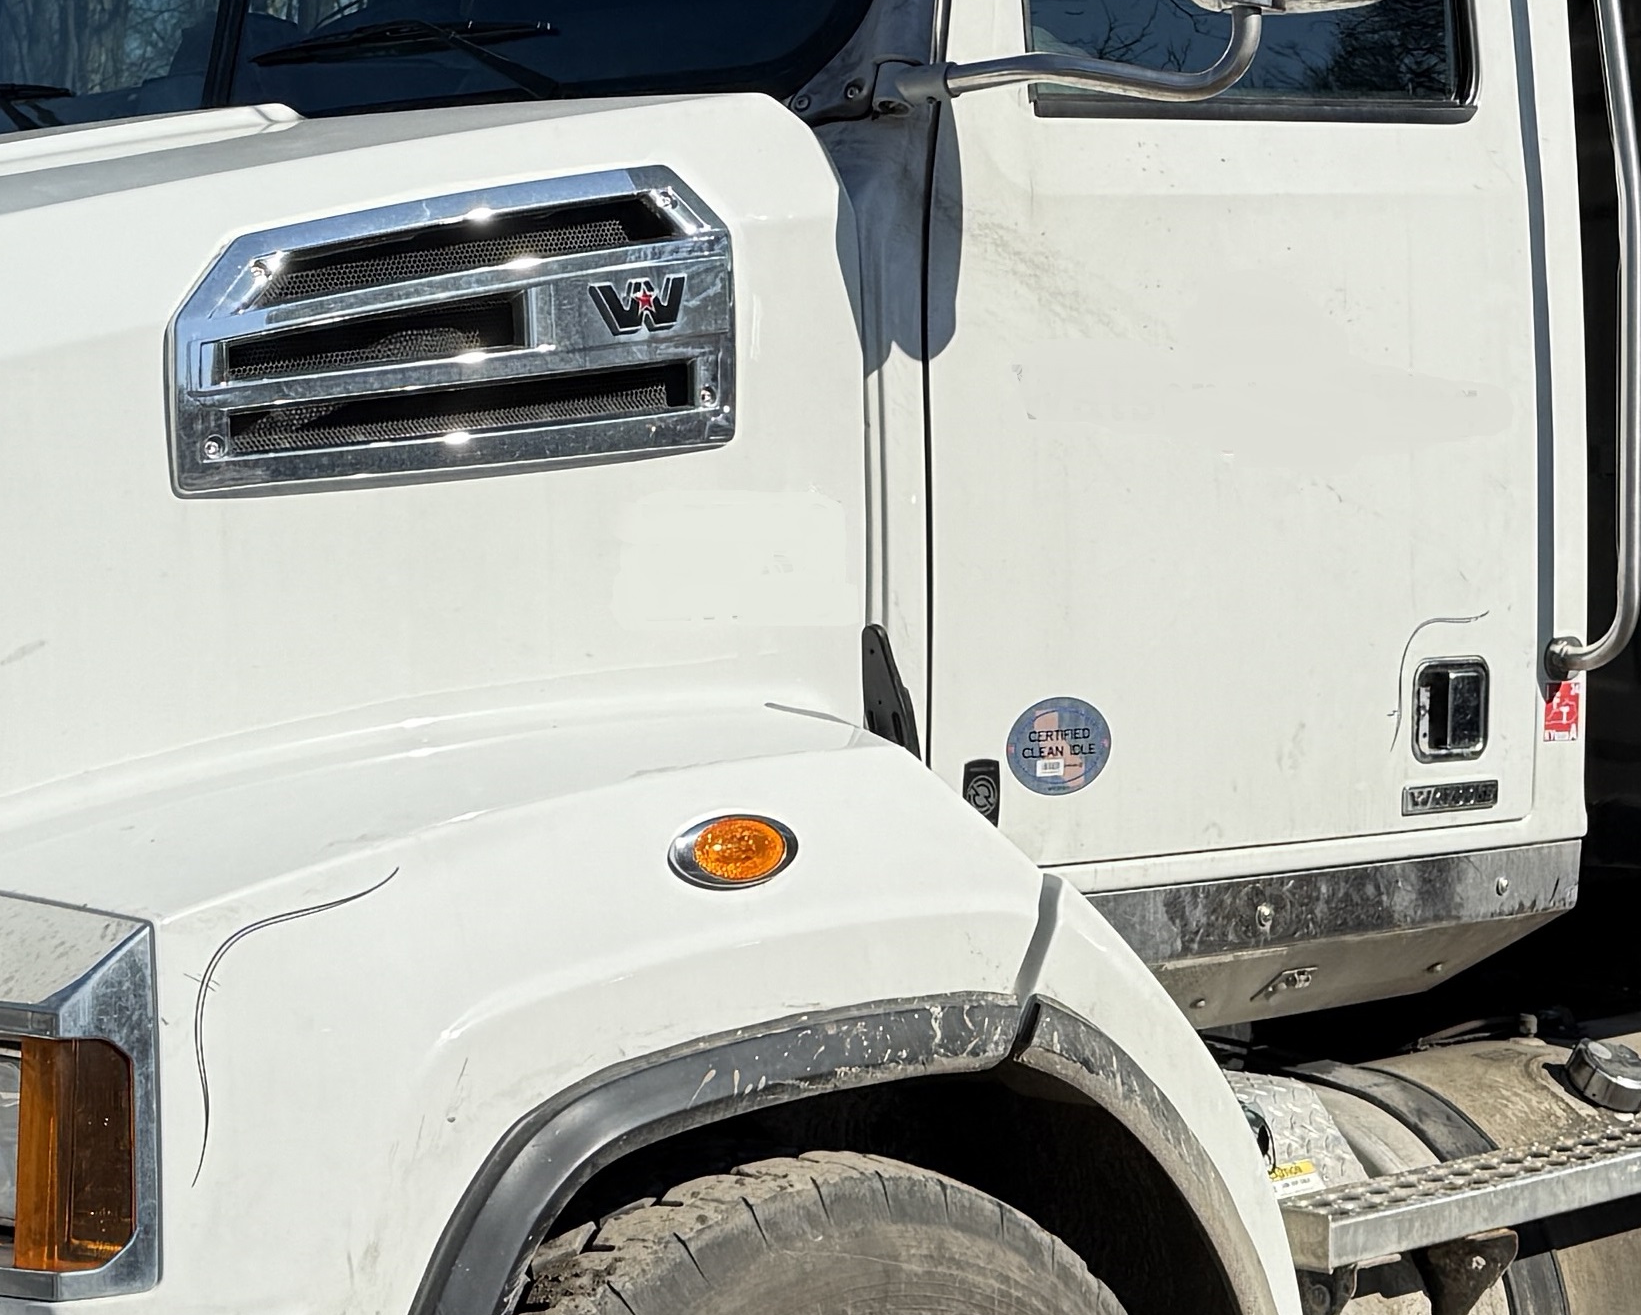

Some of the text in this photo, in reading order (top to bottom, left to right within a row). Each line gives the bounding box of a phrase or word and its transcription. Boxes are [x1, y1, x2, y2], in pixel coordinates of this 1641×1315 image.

[1028, 727, 1091, 743] CERTIFIED
[1022, 743, 1096, 759] CLEAN IDLE
